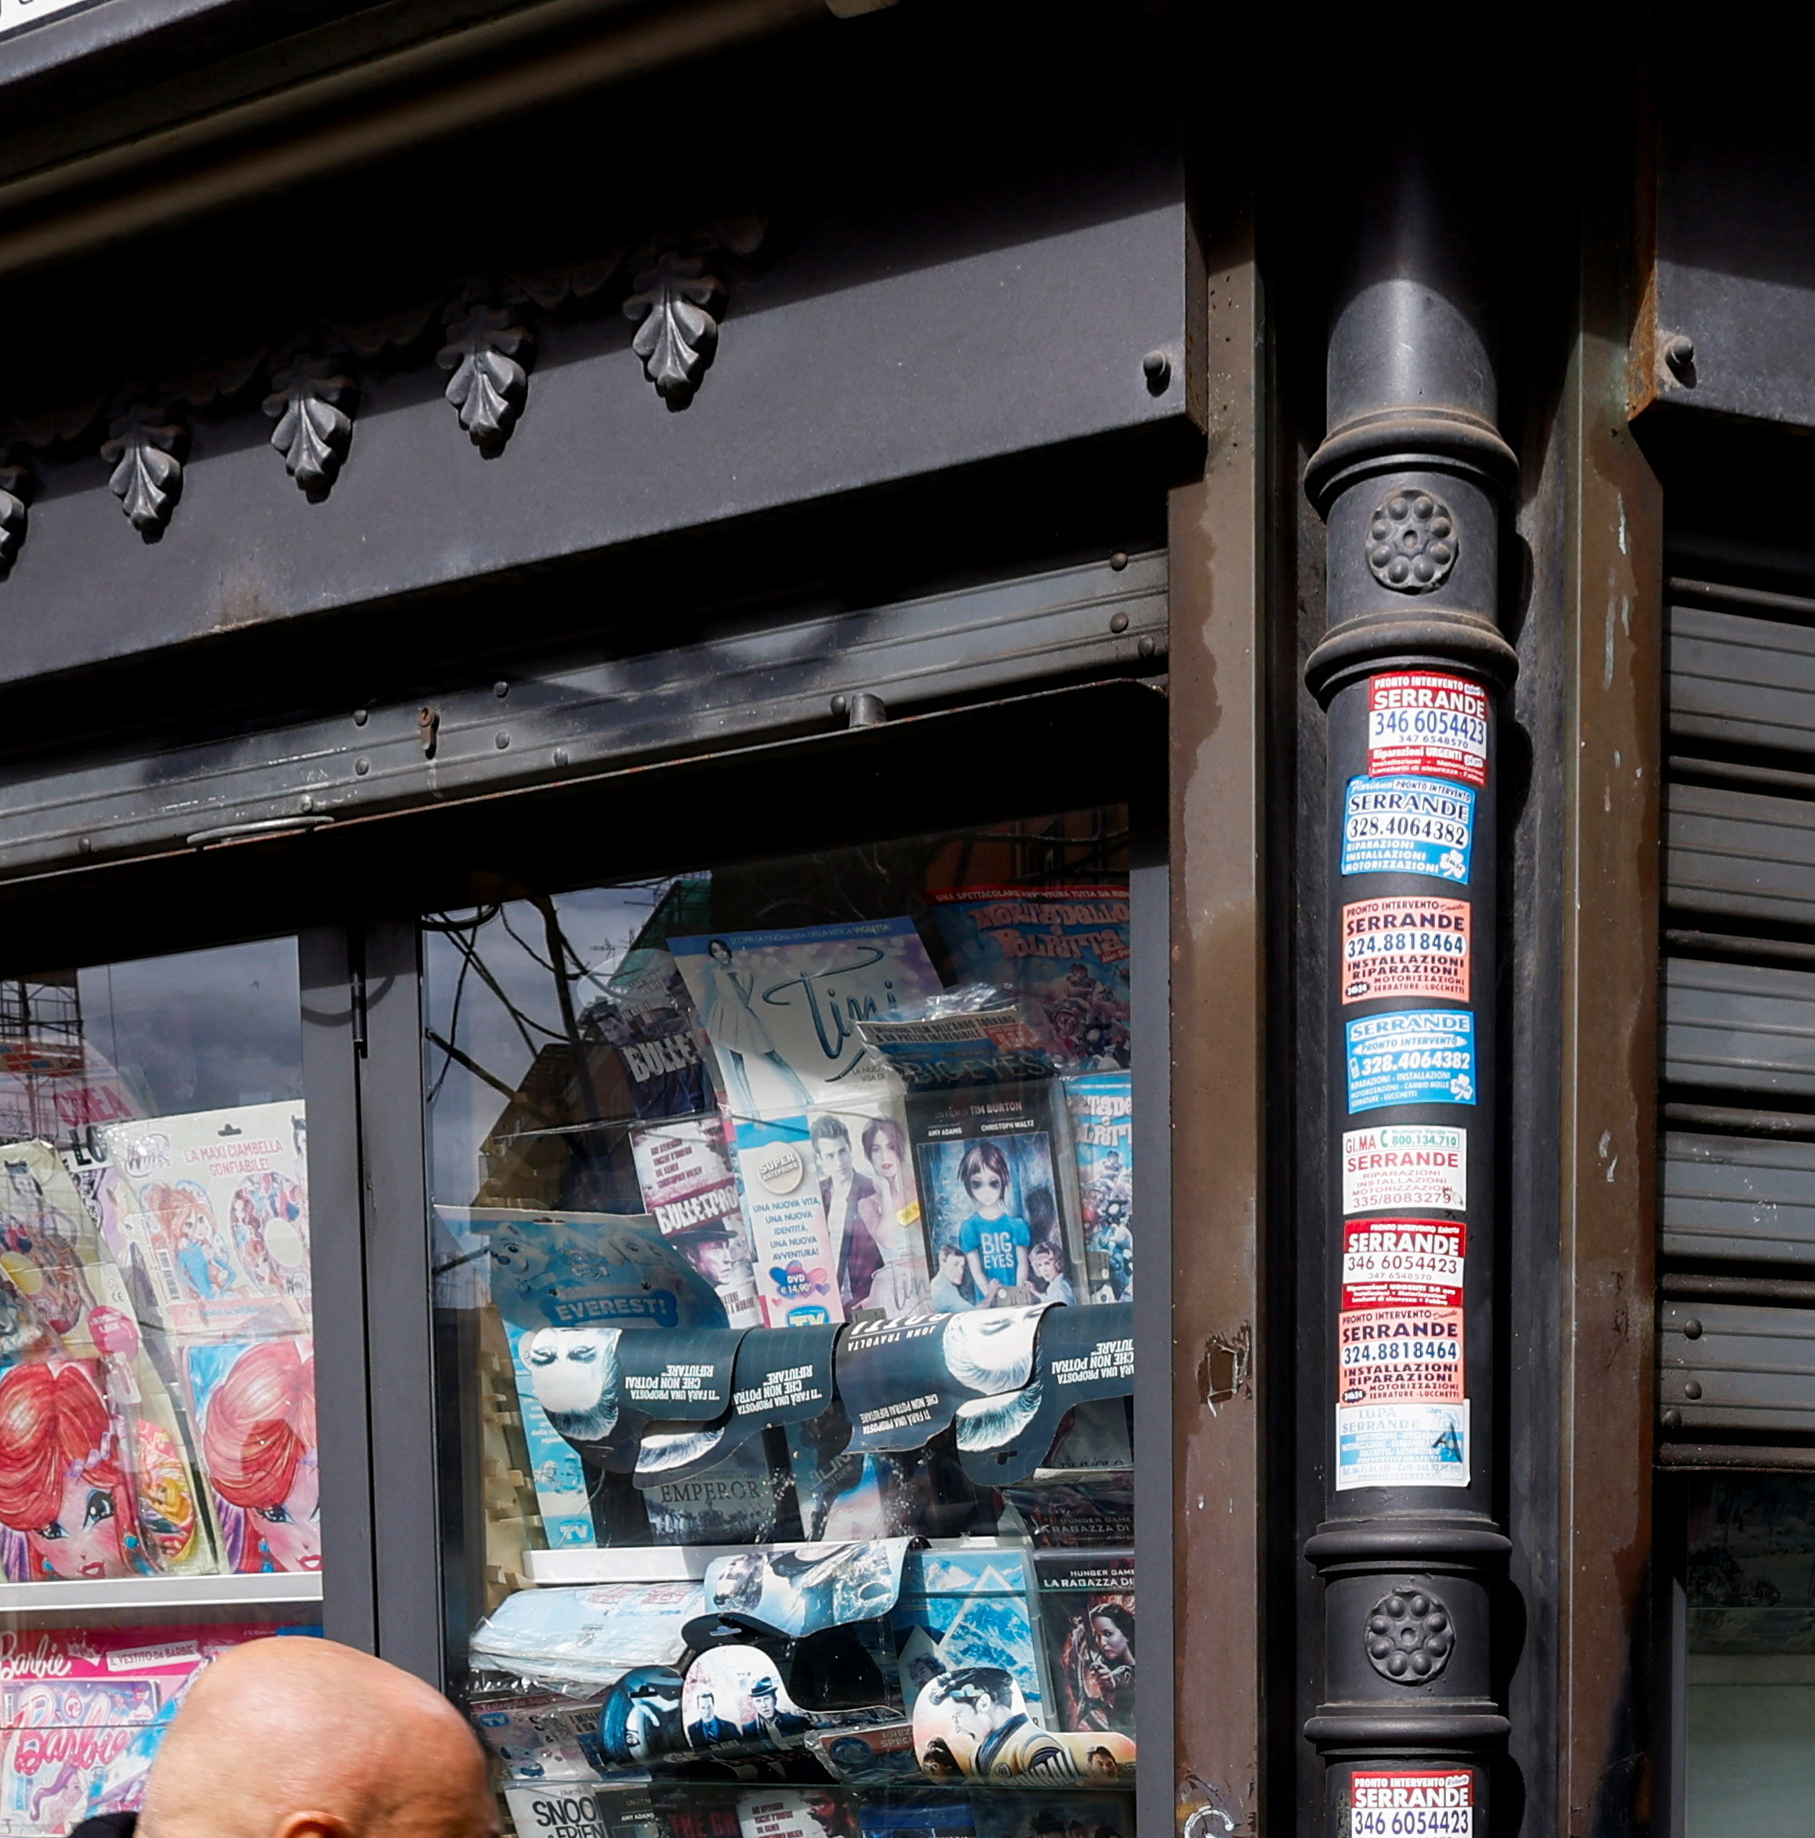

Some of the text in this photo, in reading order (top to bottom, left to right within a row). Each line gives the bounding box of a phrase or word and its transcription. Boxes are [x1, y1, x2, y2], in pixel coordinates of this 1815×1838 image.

[1374, 689, 1486, 720] SERRANDE
[1376, 710, 1485, 746] 346 6054423
[1349, 793, 1470, 823] SERRANDE
[1349, 816, 1466, 847] 328.4064382
[1346, 903, 1379, 918] PRONTO
[1381, 900, 1440, 911] INTERVENTO
[1346, 913, 1466, 937] SERRANDE
[1347, 932, 1464, 959] 324.8818464
[1347, 955, 1466, 973] INSTALLAZIONI
[1352, 965, 1459, 981] RIPARAZIONI
[1349, 1013, 1471, 1041] SERRANDE
[970, 1101, 1023, 1116] TIM BURTON
[928, 1126, 963, 1137] AMY ADAMS
[981, 1119, 1034, 1132] CHRISTOPH WALTZ
[200, 1140, 284, 1161] MAXI CIAMBELLA
[758, 1152, 796, 1174] SUPER
[1347, 1152, 1459, 1173] SERRANDE
[753, 1199, 800, 1213] UNA NUOVA
[765, 1210, 814, 1223] UNA NUOVA
[770, 1236, 818, 1249] UNA NUOVA
[981, 1231, 1015, 1268] BIG EYES
[1347, 1231, 1460, 1257] SERRANDE
[772, 1248, 820, 1261] AVVENTURA!
[1347, 1255, 1458, 1276] 346 6054423
[787, 1274, 805, 1285] DVD
[557, 1297, 666, 1321] EVEREST!
[1341, 1309, 1432, 1326] PRONTO INTERVENTO
[847, 1325, 937, 1352] JOHN TRAVOLTA
[1341, 1322, 1459, 1344] SERRANDE
[1343, 1341, 1457, 1365] 324.8818464
[1052, 1355, 1113, 1375] NON POTRAI
[1344, 1363, 1459, 1379] INSTALLAZIONI
[625, 1377, 702, 1390] CHE NON POTRAI
[763, 1379, 803, 1397] CHE NON
[1058, 1371, 1098, 1385] PROPOSTA
[1348, 1372, 1453, 1388] RIPARAZIONI
[631, 1388, 688, 1401] UNA PROPOSTA
[773, 1394, 789, 1407] UNA
[660, 1482, 760, 1503] EMPEROR
[1044, 1578, 1117, 1589] LA RAGAZZA
[1070, 1569, 1104, 1578] HUNGER
[118, 1644, 194, 1665] VESTITO BARBIE
[14, 1684, 132, 1777] Barbie
[1354, 1787, 1469, 1808] SERRANDE
[1354, 1810, 1469, 1835] 346 6054423
